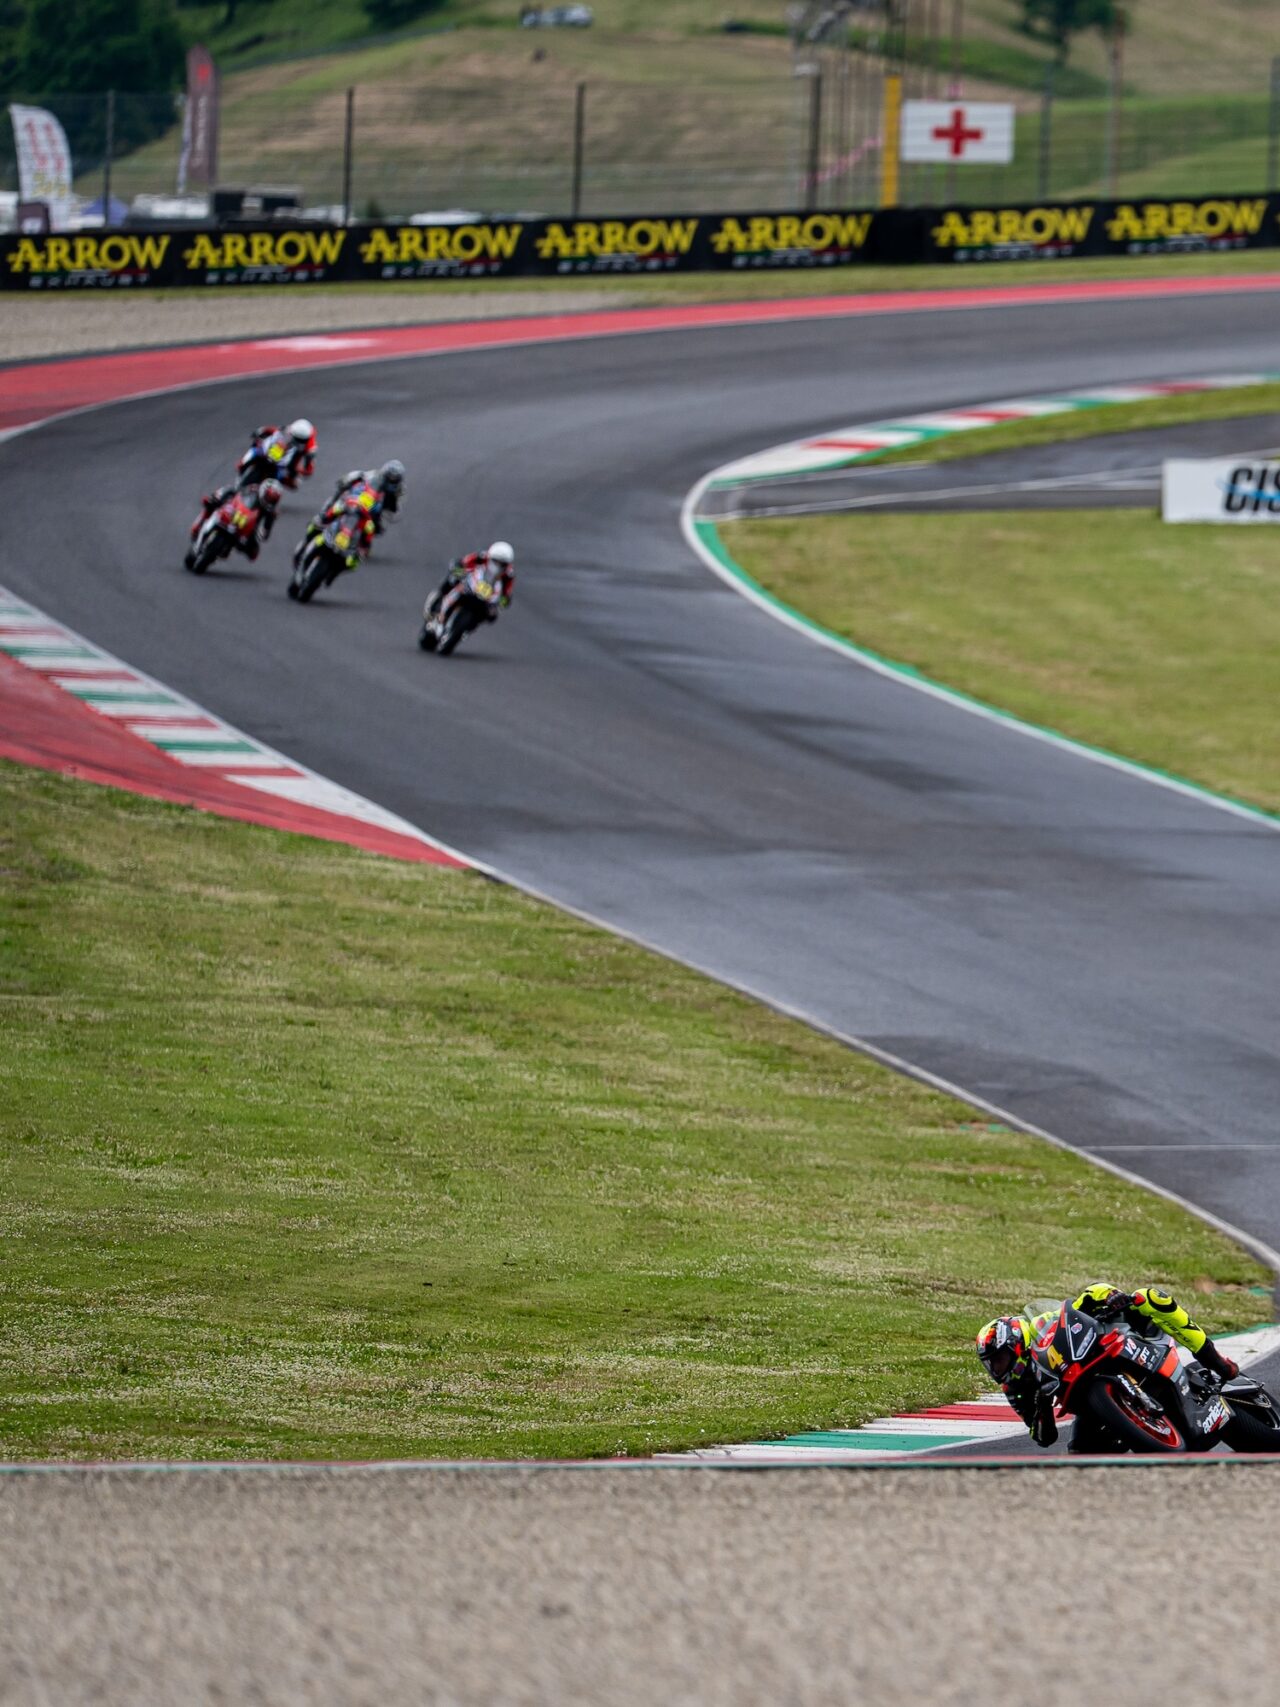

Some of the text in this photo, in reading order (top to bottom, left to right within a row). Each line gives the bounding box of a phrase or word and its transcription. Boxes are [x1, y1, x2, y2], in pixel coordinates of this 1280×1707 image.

[535, 220, 698, 257] ARROW
[710, 215, 873, 252] ARROW
[932, 207, 1094, 247] ARROW
[1106, 200, 1266, 240] ARROW
[8, 235, 170, 272] ARROW
[184, 231, 345, 267] ARROW
[360, 226, 522, 261] ARROW
